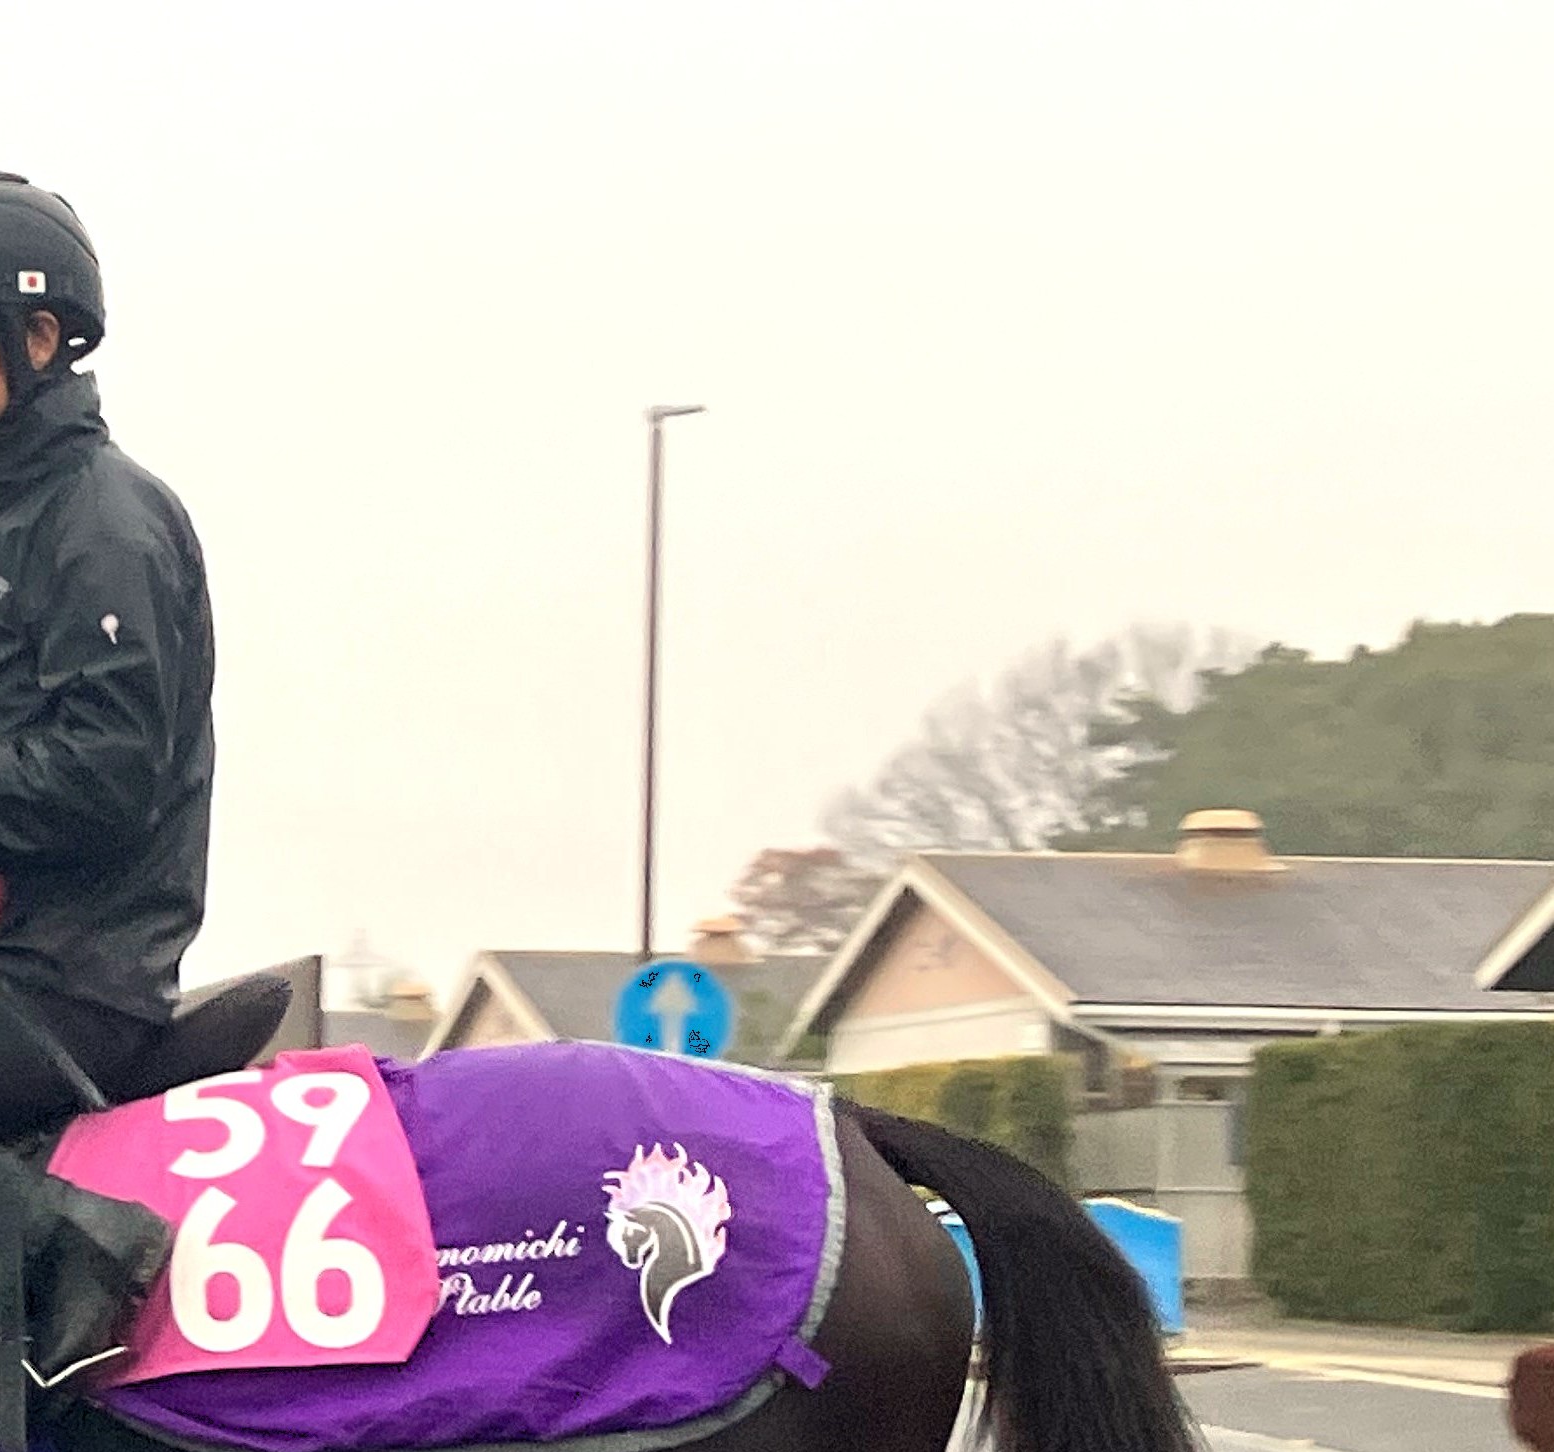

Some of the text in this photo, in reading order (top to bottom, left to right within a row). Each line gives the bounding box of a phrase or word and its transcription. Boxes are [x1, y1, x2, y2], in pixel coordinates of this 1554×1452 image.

[164, 1070, 370, 1179] 59
[169, 1177, 385, 1353] 66
[436, 1219, 585, 1267] nomichi
